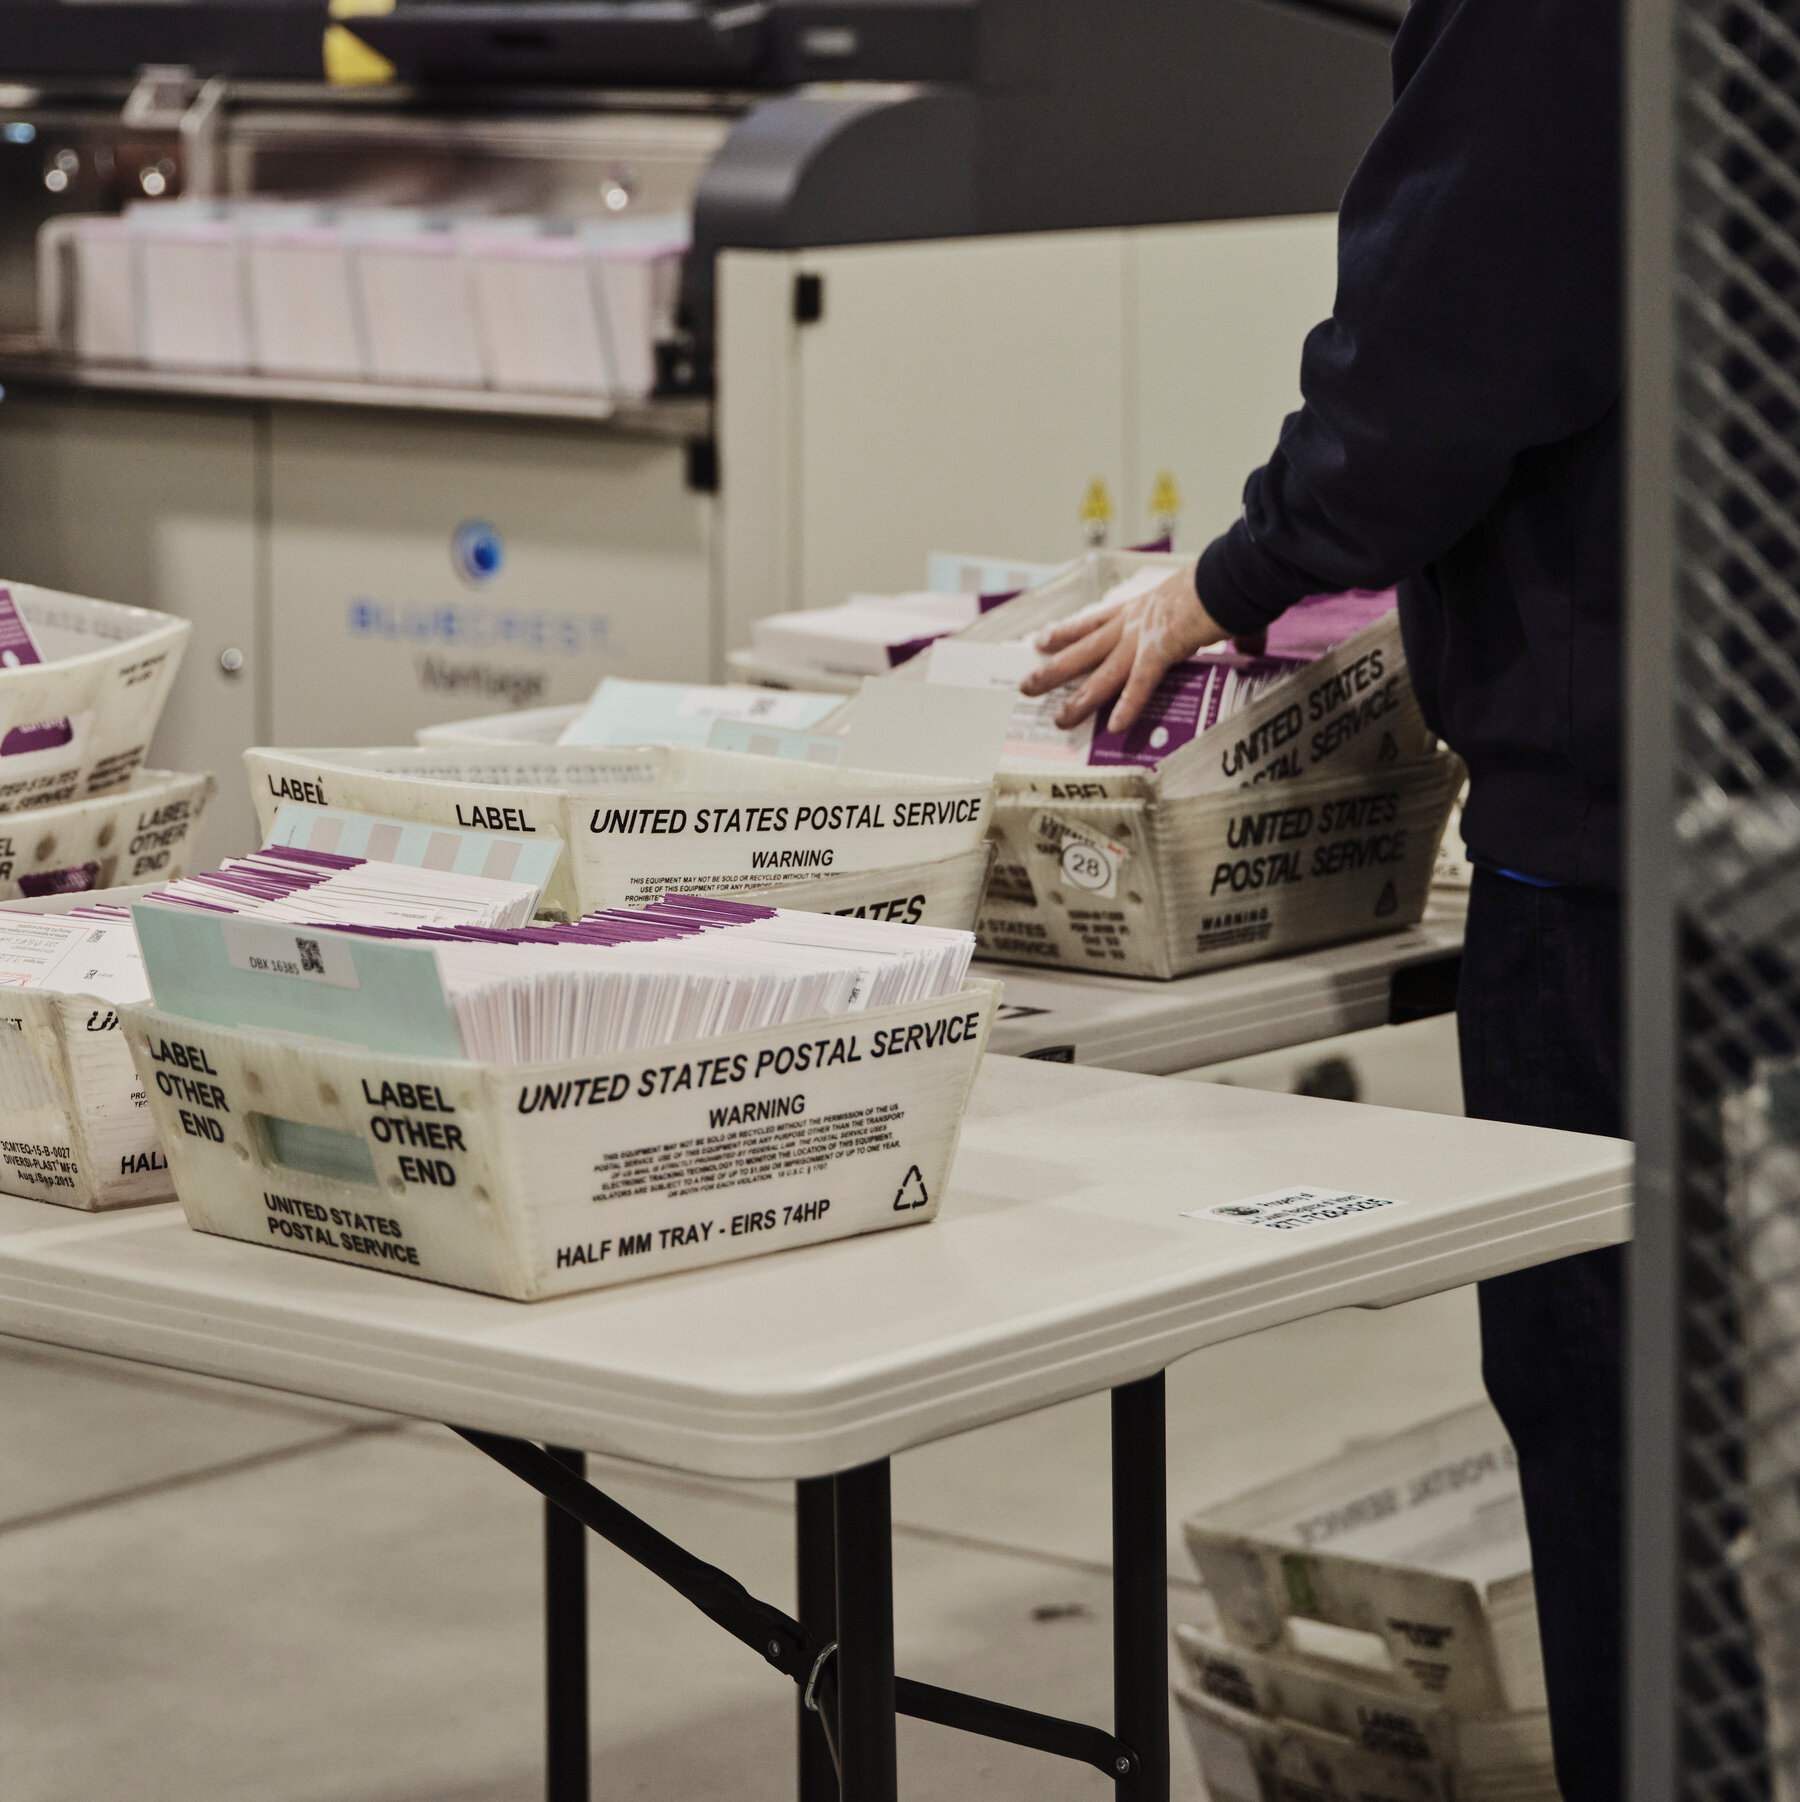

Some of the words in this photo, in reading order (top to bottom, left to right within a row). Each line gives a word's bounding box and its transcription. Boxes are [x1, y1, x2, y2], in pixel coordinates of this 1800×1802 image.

[1222, 704, 1303, 776] UNITED
[1309, 650, 1383, 722] STATES
[268, 774, 328, 805] LABEL
[138, 800, 191, 832] LABEL
[455, 804, 536, 832] LABEL
[590, 810, 687, 834] UNITED
[694, 808, 789, 833] STATES
[794, 804, 885, 831] POSTAL
[893, 799, 981, 827] SERVICE
[1227, 807, 1313, 850] UNITED
[1317, 791, 1400, 835] STATES
[129, 822, 189, 856] OTHER
[133, 849, 171, 877] END
[752, 849, 834, 868] WARNING
[1072, 853, 1100, 878] 28
[1210, 853, 1304, 896] POSTAL
[630, 877, 644, 885] THIS
[645, 876, 682, 885] EQUIPMENT
[749, 873, 782, 881] RECYCLED
[783, 872, 809, 880] WITHOUT
[680, 884, 716, 892] EQUIPMENT
[249, 956, 269, 969] DBX
[146, 1033, 217, 1076] LABEL
[518, 1074, 630, 1114] UNITED
[637, 1054, 748, 1097] STATES
[754, 1036, 862, 1078] POSTAL
[870, 1012, 980, 1058] SERVICE
[156, 1070, 230, 1113] OTHER
[361, 1078, 455, 1113] LABEL
[179, 1109, 225, 1143] END
[709, 1094, 805, 1128] WARNING
[740, 1125, 775, 1136] RECYCLED
[777, 1119, 807, 1131] WITHOUT
[809, 1117, 822, 1125] THE
[824, 1110, 863, 1123] PERMISSION
[889, 1103, 899, 1111] US
[774, 1130, 806, 1140] PURPOSE
[808, 1126, 830, 1135] OTHER
[832, 1122, 850, 1131] THAN
[852, 1119, 864, 1128] THE
[866, 1111, 905, 1124] TRANSPORT
[370, 1116, 467, 1152] OTHER
[793, 1144, 826, 1156] LOCATION
[839, 1140, 853, 1148] THIS
[60, 1161, 78, 1174] MFG
[398, 1156, 457, 1187] END
[783, 1152, 834, 1168] IMPRISONMENT
[835, 1150, 844, 1158] OF
[845, 1148, 855, 1156] UP
[857, 1147, 865, 1155] TO
[867, 1144, 880, 1153] ONE
[263, 1192, 328, 1222] UNITED
[329, 1207, 402, 1238] STATES
[267, 1216, 338, 1247] POSTAL
[341, 1231, 420, 1265] SERVICE
[557, 1239, 611, 1268] HALF
[618, 1232, 651, 1258] MM
[658, 1220, 713, 1249] TRAY
[731, 1209, 775, 1236] EIRS
[783, 1198, 830, 1226] 74HP
